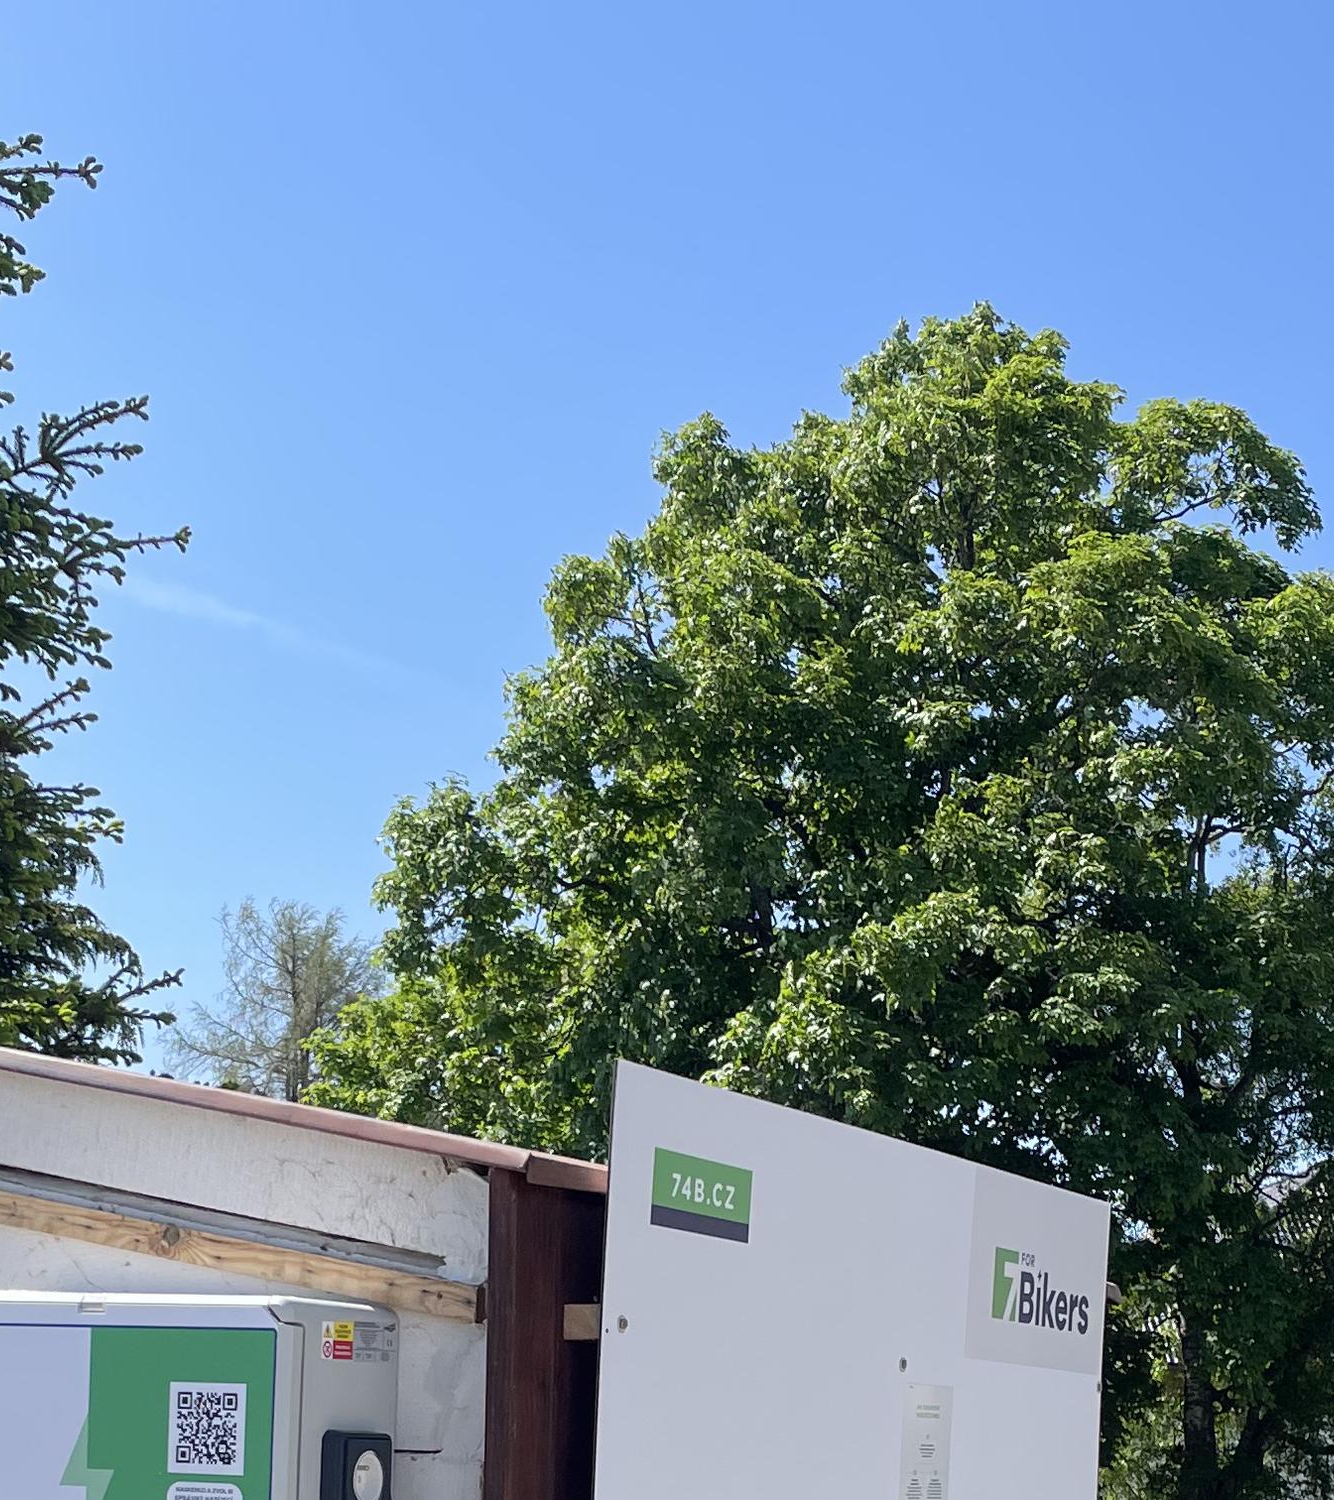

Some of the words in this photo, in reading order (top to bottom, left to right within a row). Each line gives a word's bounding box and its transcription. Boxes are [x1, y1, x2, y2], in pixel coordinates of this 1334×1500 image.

[671, 1172, 736, 1210] 74B.CZ
[1021, 1252, 1036, 1268] FOR
[1018, 1269, 1090, 1335] Bikers
